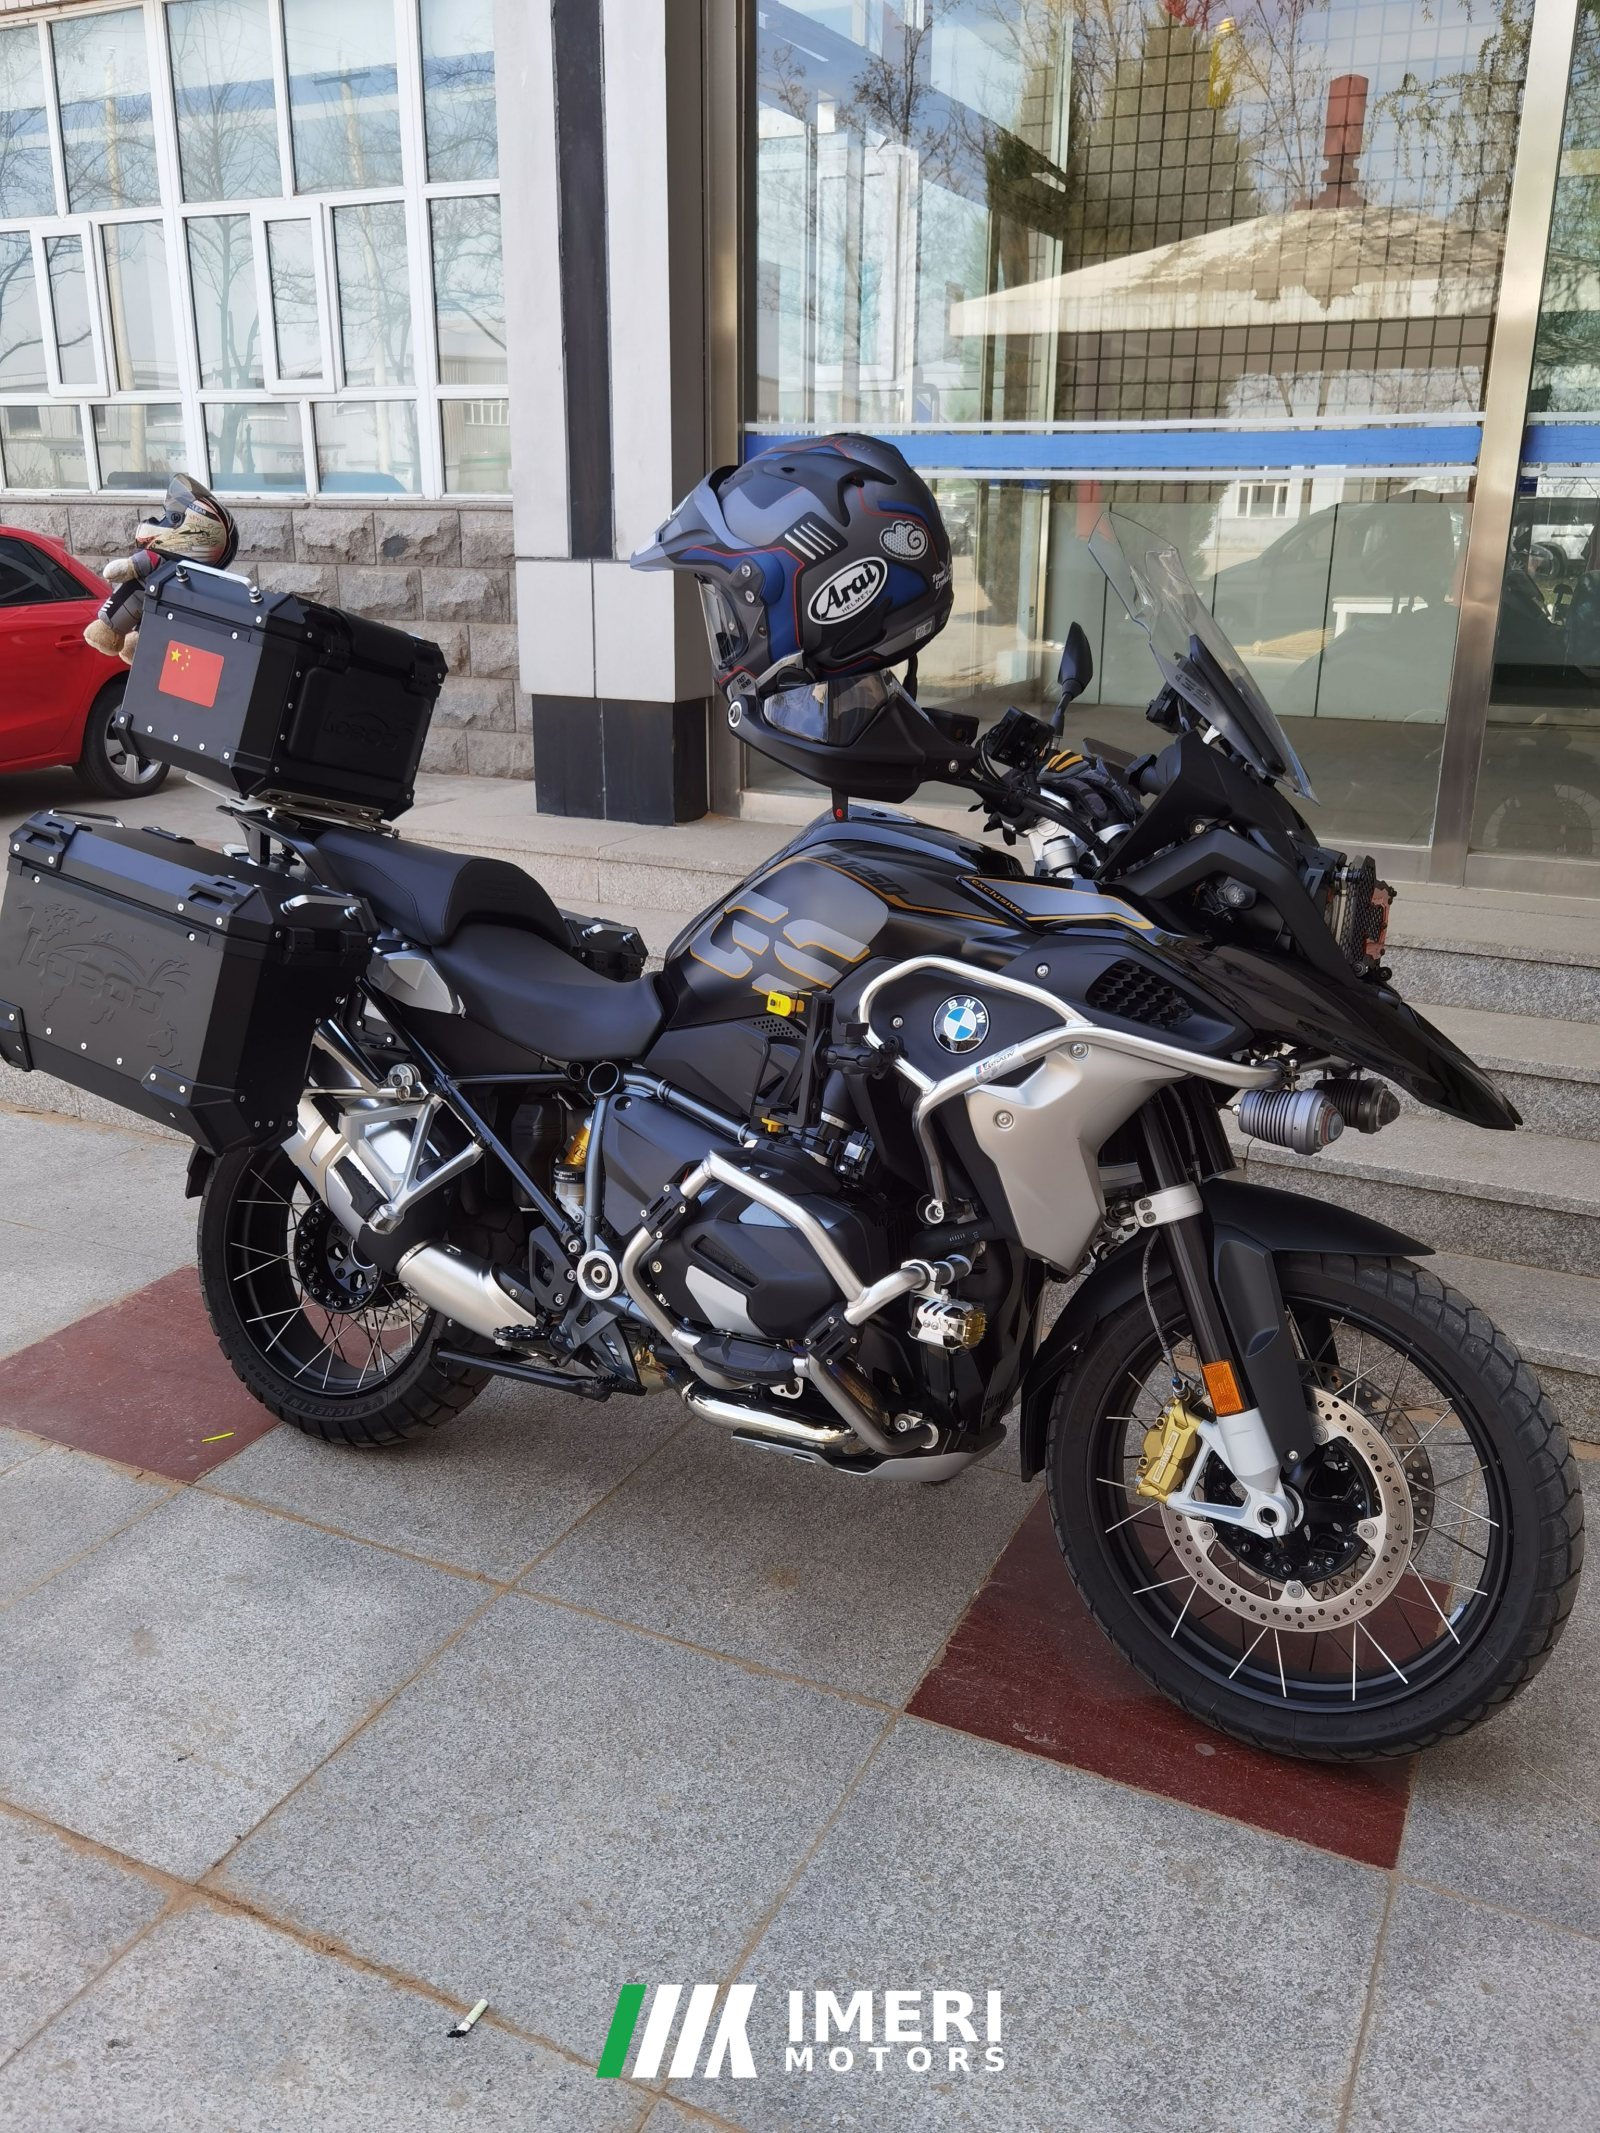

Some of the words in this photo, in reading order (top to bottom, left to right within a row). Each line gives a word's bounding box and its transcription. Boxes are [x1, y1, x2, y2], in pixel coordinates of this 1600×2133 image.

[820, 562, 877, 620] Arai
[970, 878, 1025, 916] exclusive
[947, 998, 987, 1024] BMW
[289, 1398, 366, 1417] MICHELIN
